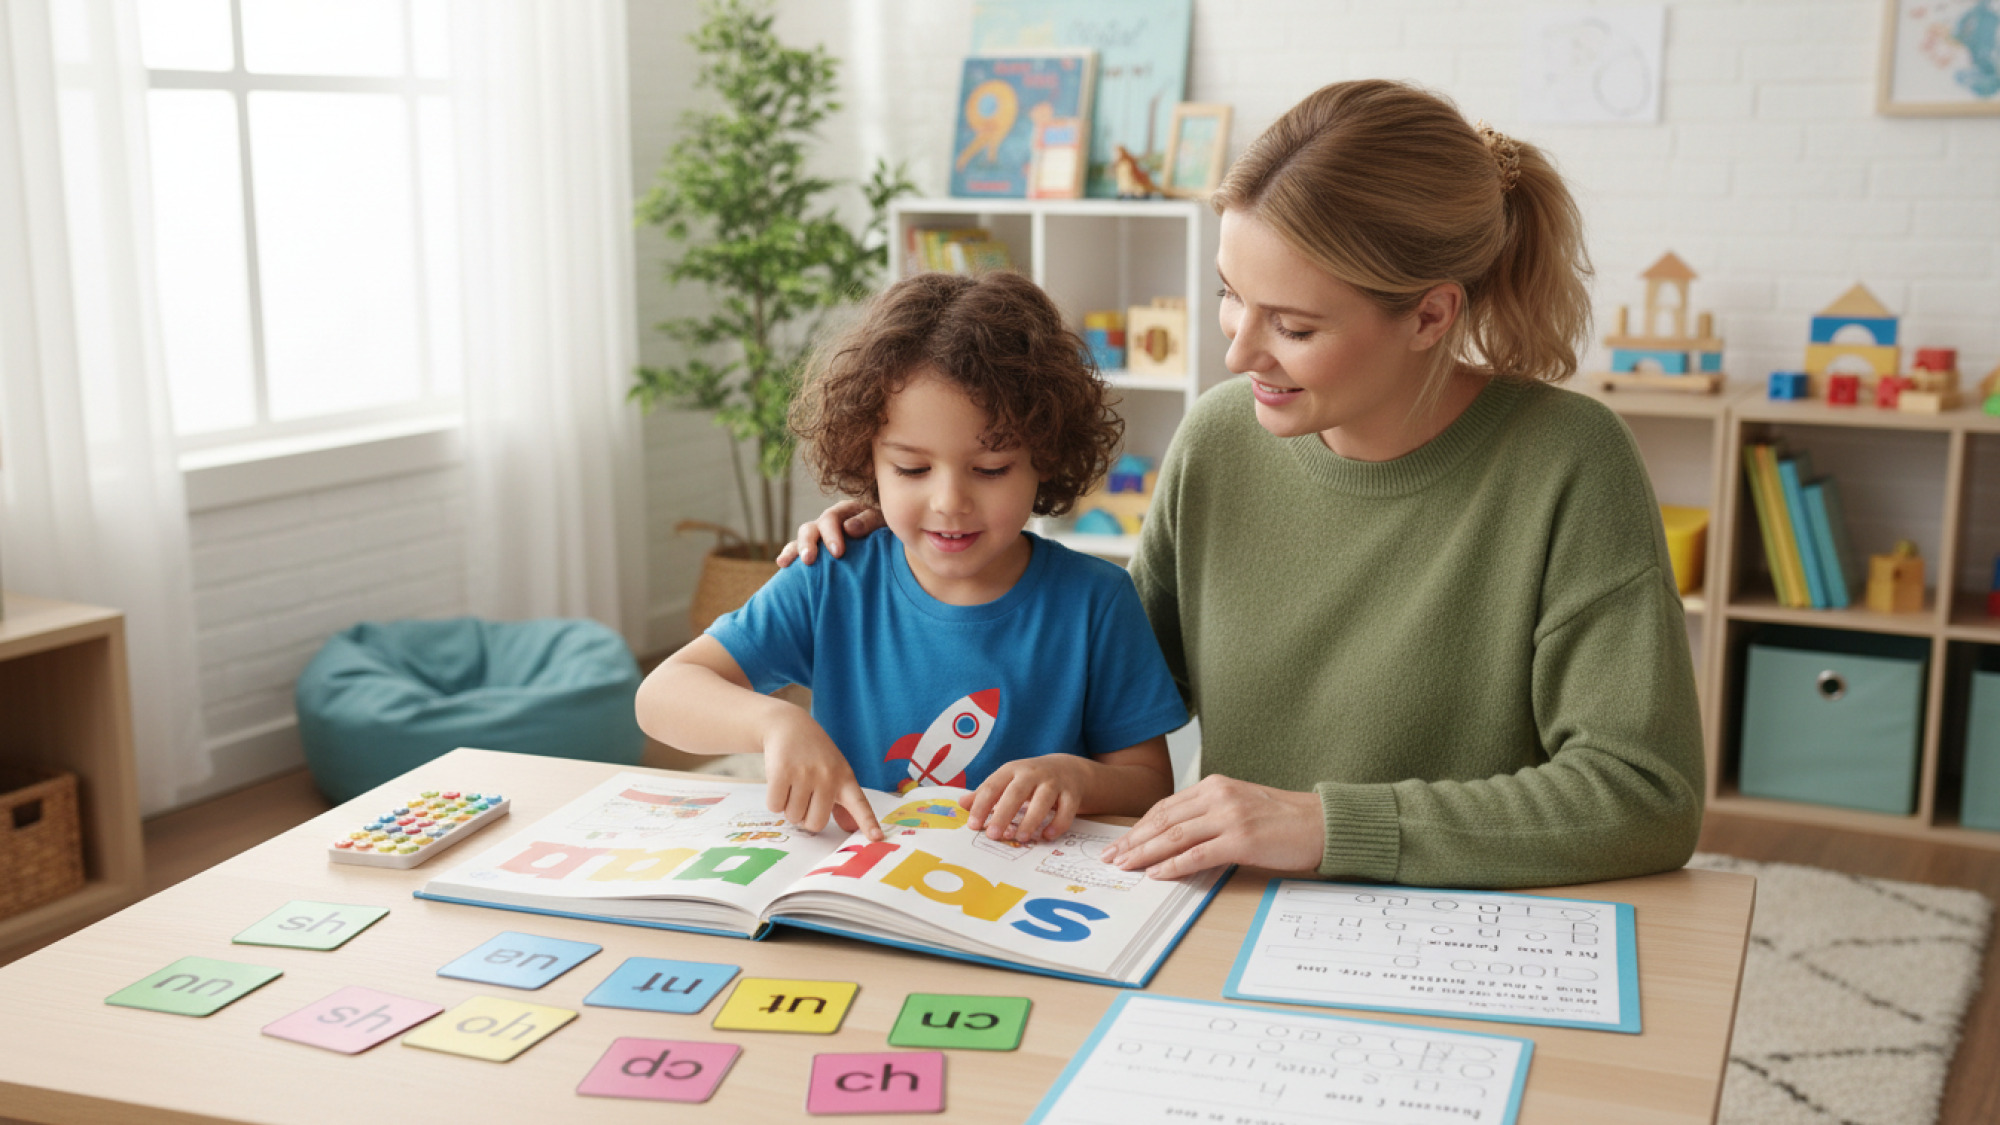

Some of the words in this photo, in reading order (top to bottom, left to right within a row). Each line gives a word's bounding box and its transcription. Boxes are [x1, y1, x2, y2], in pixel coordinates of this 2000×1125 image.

[277, 911, 347, 937] sh
[317, 1003, 394, 1034] sh
[835, 1063, 919, 1092] ch
